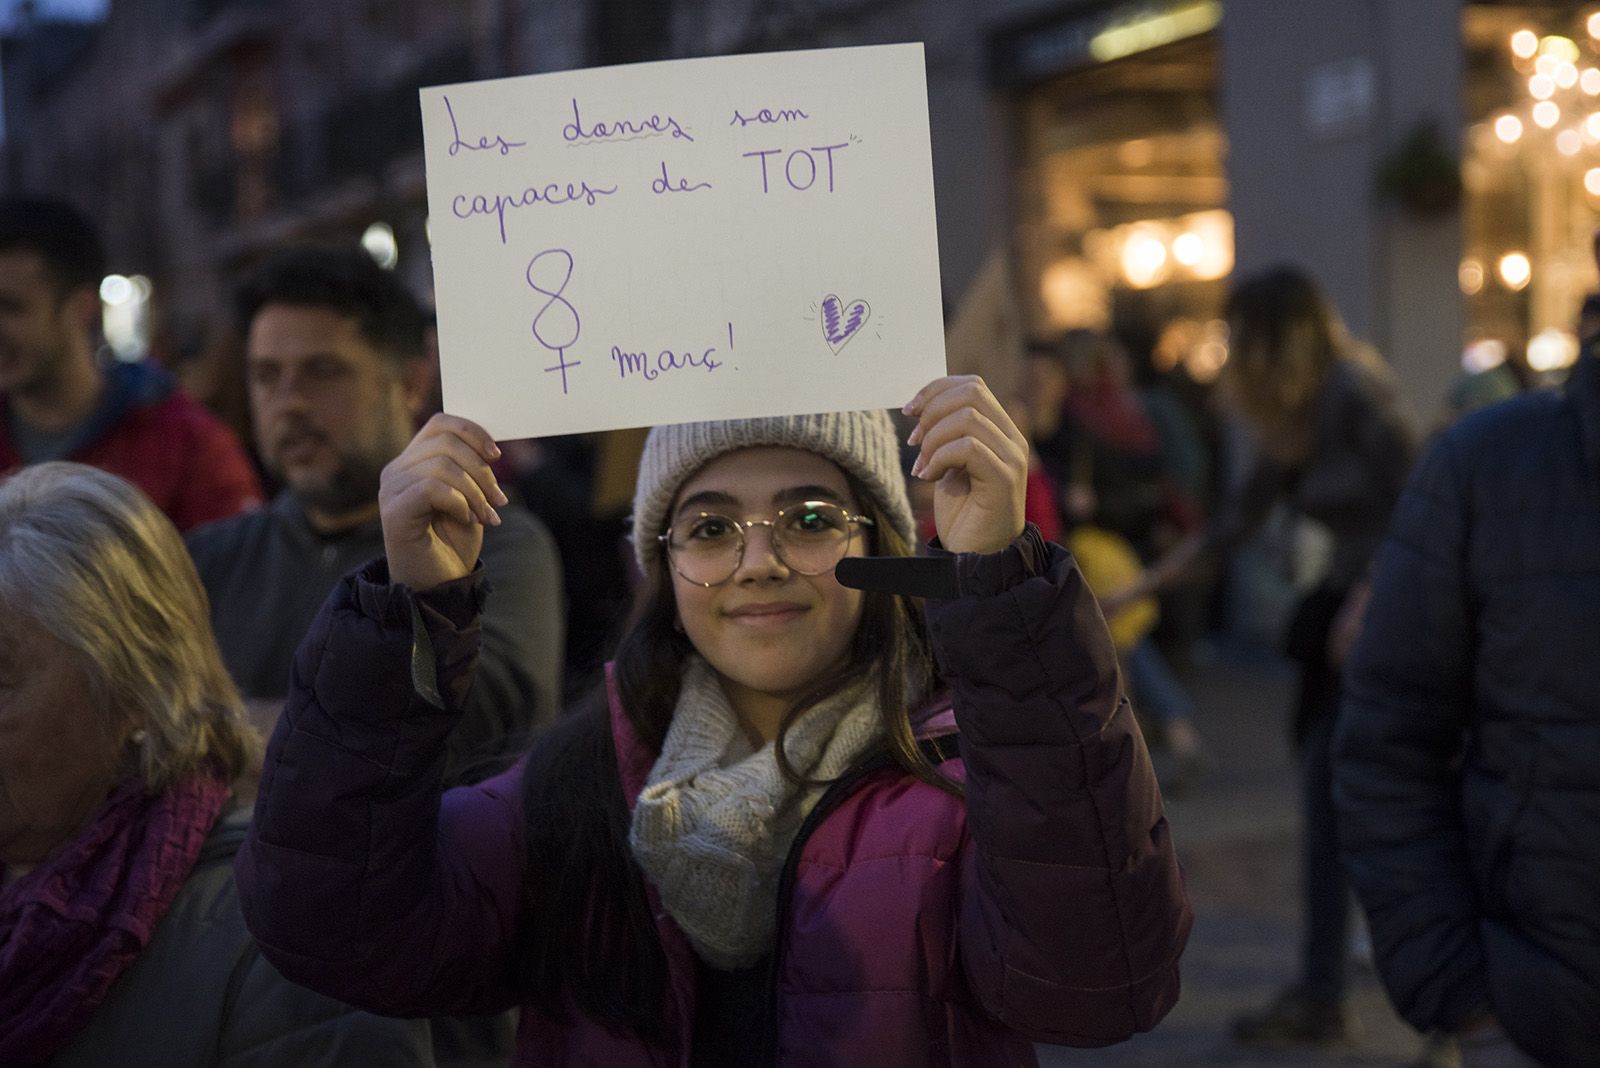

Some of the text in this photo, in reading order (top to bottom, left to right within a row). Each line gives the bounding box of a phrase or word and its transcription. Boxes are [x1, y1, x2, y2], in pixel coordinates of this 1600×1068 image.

[442, 95, 527, 156] Les
[452, 142, 849, 244] capaces de TOT
